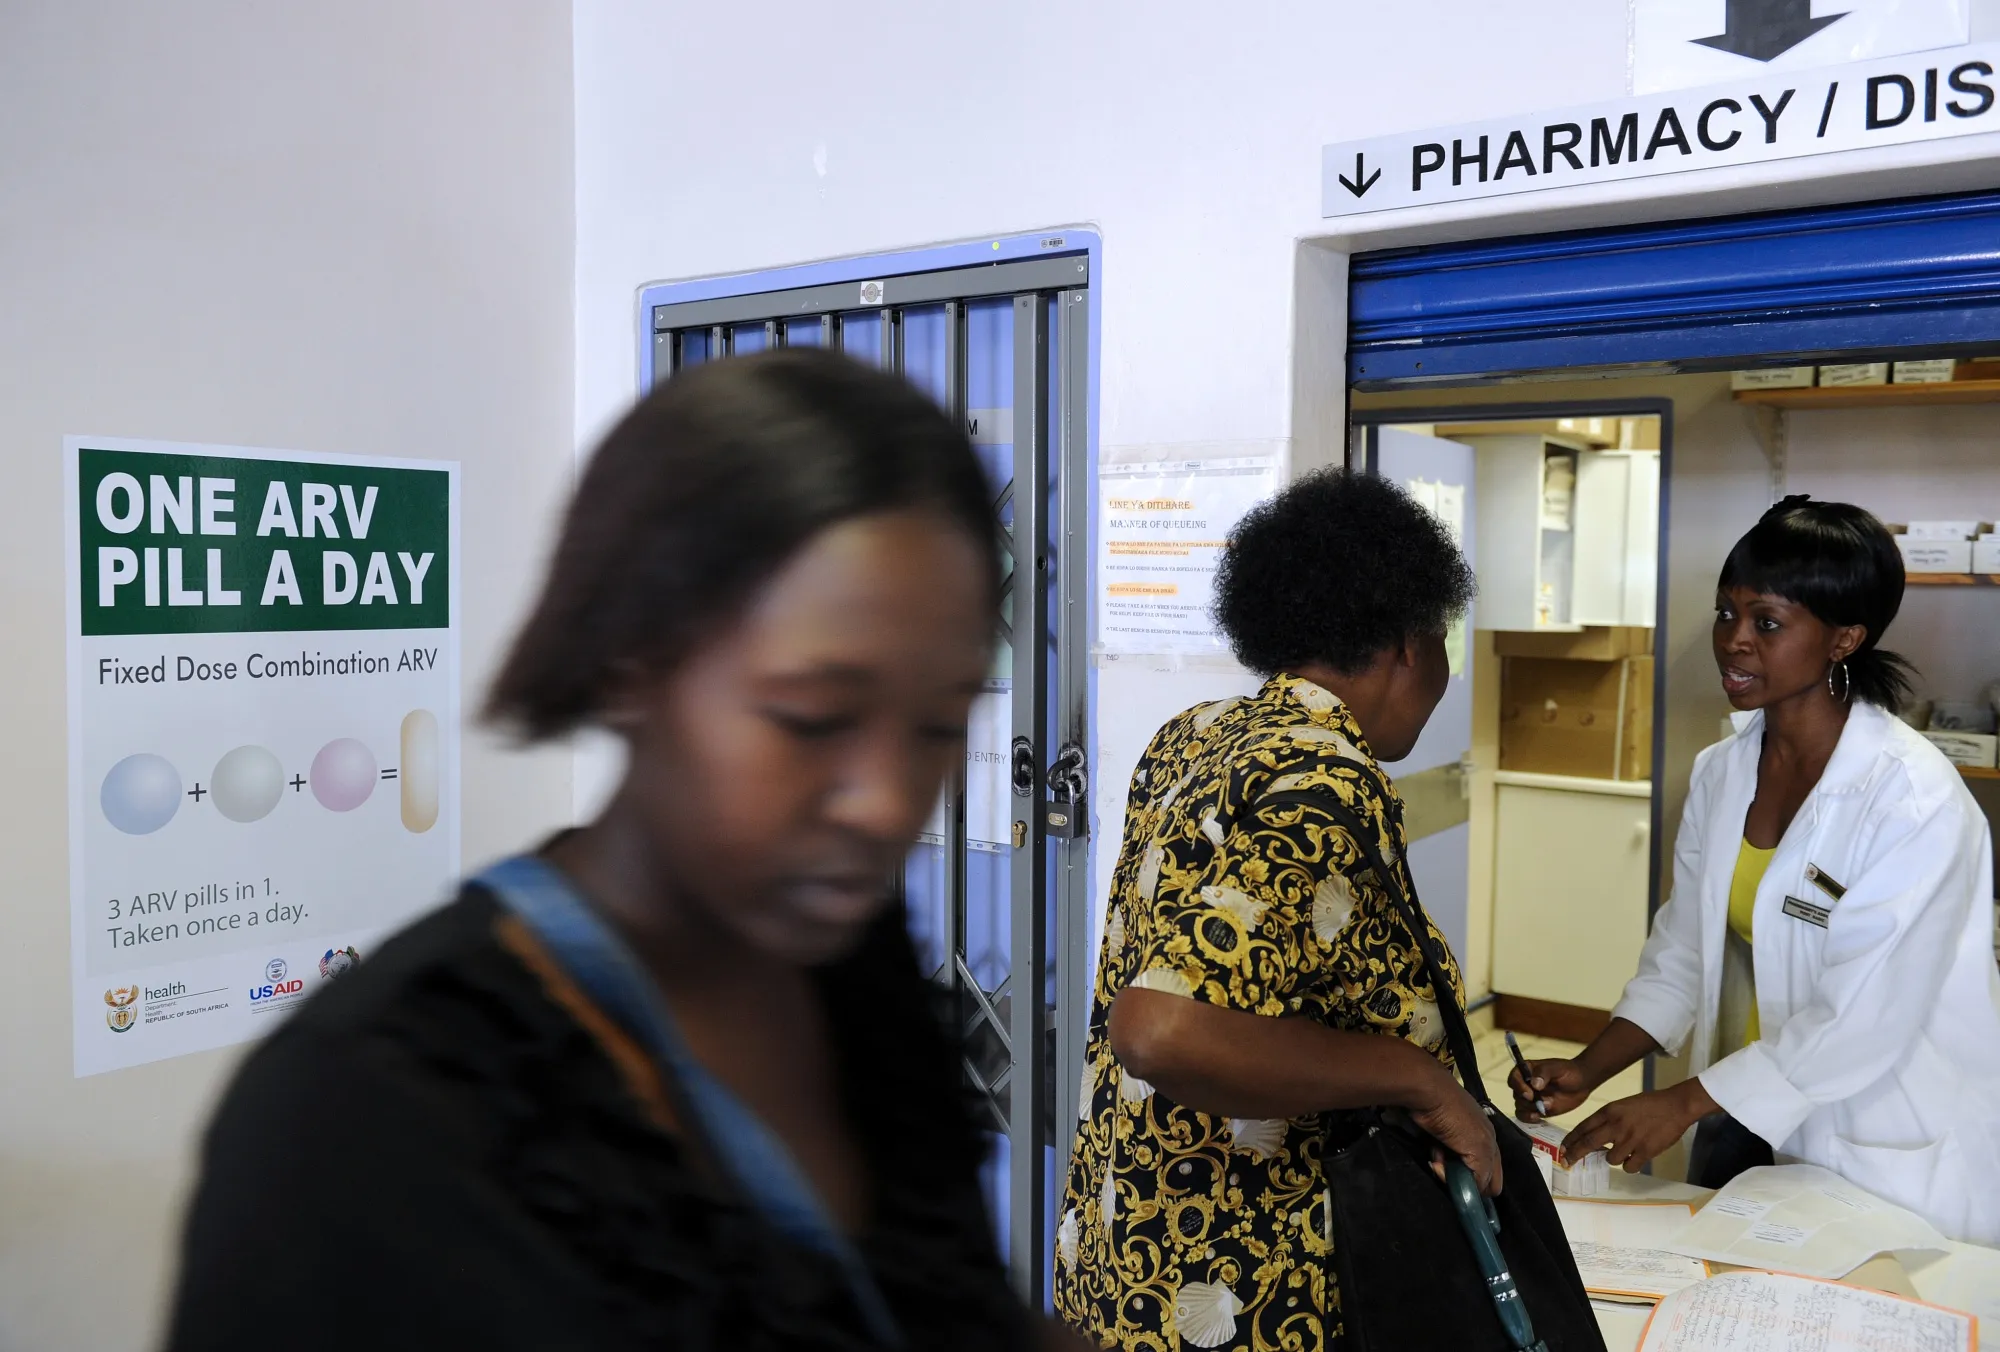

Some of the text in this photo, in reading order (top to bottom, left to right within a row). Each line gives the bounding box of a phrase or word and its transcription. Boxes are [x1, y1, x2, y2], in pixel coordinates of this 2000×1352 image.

[1411, 88, 1796, 192] PHARMACY
[1816, 81, 1840, 138] /
[96, 472, 379, 540] ONE ARV
[1131, 500, 1145, 510] YA
[1147, 500, 1191, 510] DITLHARE
[1109, 519, 1207, 530] MANNER OF QUEUEING
[98, 546, 435, 607] PILL A DAY
[99, 648, 438, 685] Fixed Dose Combination ARV
[974, 751, 1007, 765] ENTRY
[108, 877, 280, 920] 3 ARV pills in 1.
[107, 902, 309, 949] Taken once a day.
[145, 981, 186, 1001] health
[249, 979, 303, 1001] USAID
[145, 1013, 176, 1024] REPUBLIC
[186, 1007, 207, 1016] SOUTH
[207, 1002, 229, 1012] AFRICA
[145, 1010, 163, 1018] Health
